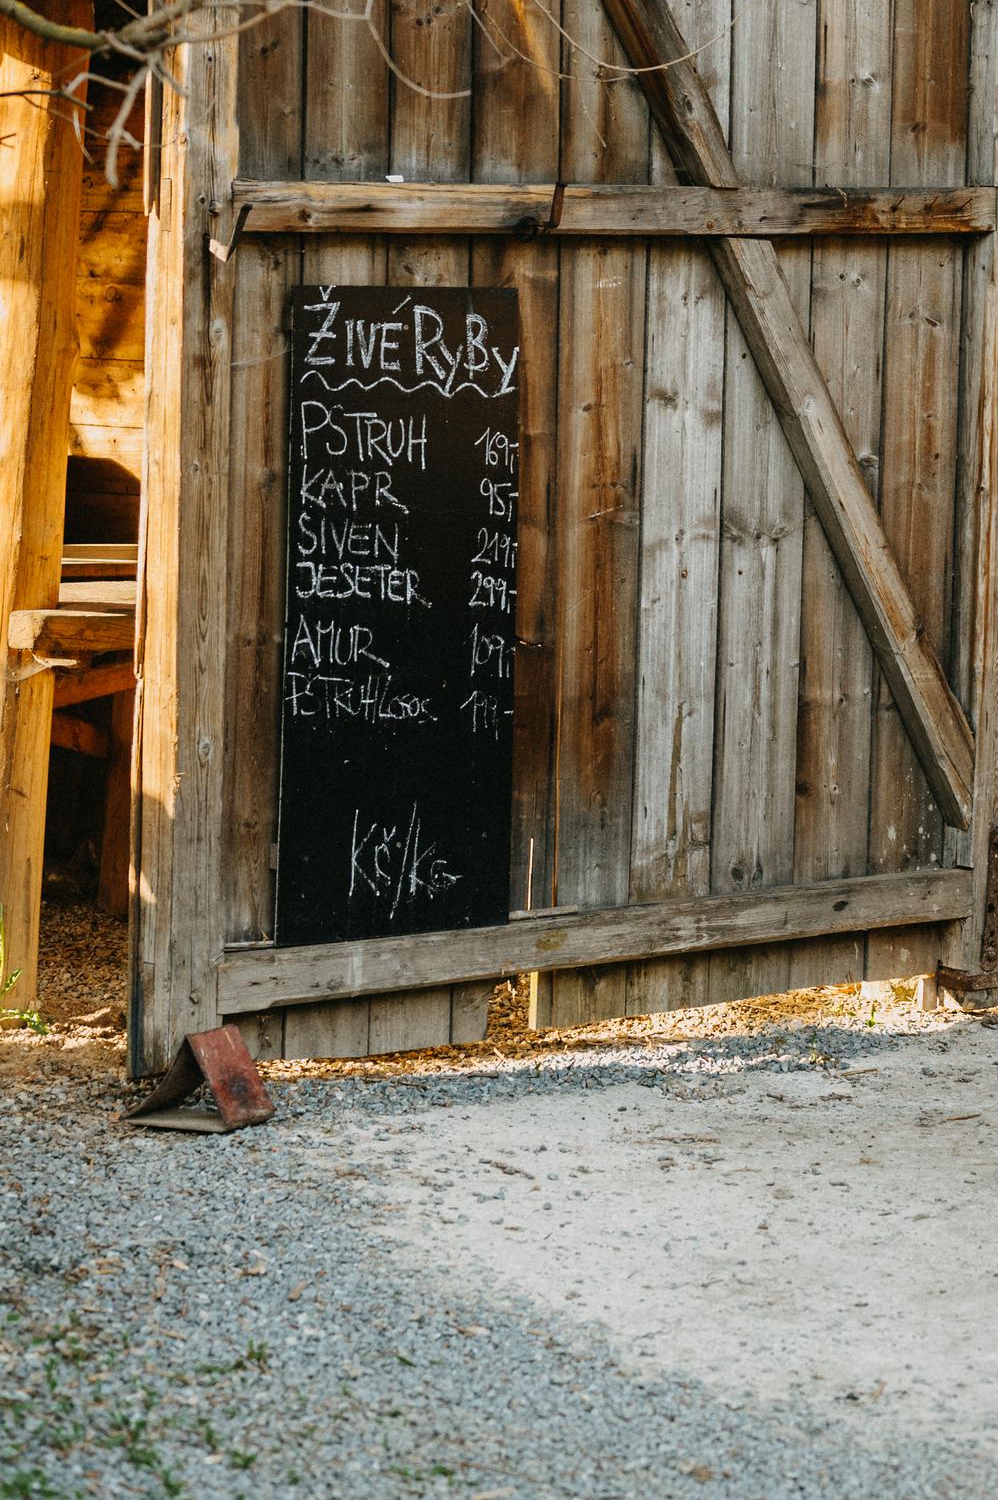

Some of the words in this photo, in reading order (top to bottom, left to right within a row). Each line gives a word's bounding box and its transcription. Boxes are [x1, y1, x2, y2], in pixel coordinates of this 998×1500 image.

[303, 285, 411, 371] ŽIVÉ
[301, 400, 427, 470] PSTRUH
[301, 465, 410, 514] KAPR
[298, 512, 400, 564] SIVEN
[296, 561, 433, 608] JESETER
[291, 614, 390, 668] AMUR
